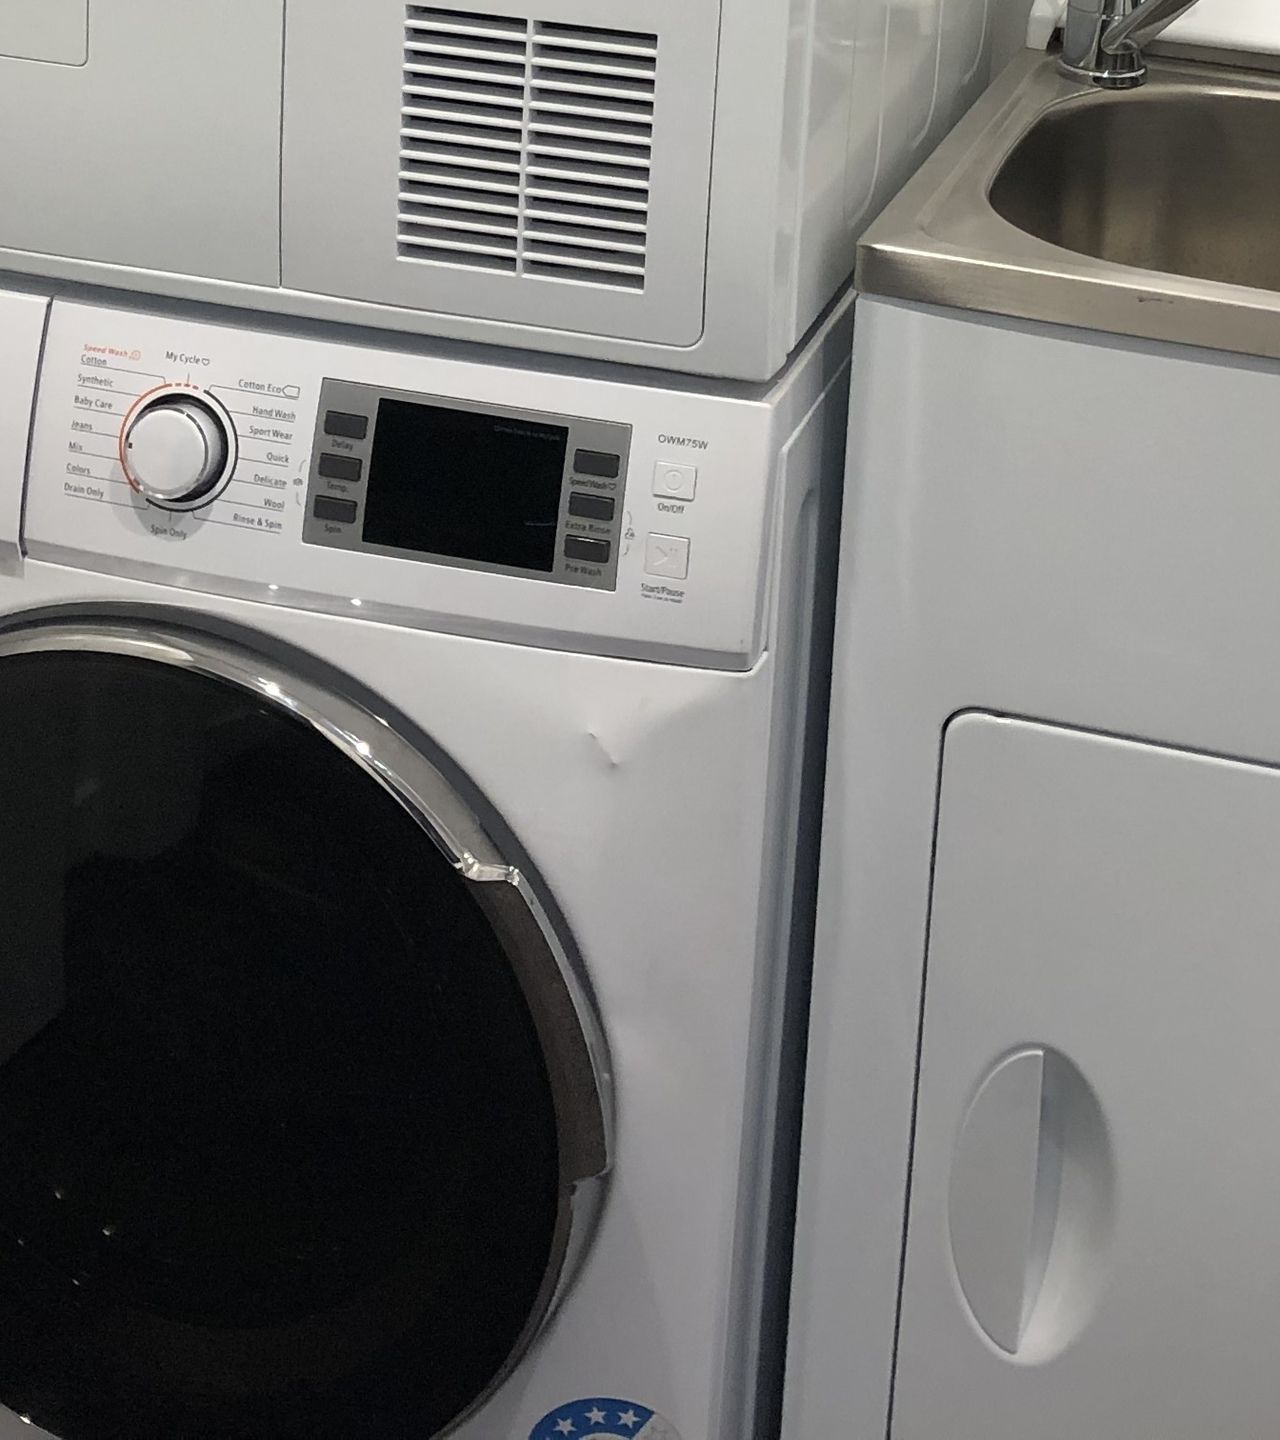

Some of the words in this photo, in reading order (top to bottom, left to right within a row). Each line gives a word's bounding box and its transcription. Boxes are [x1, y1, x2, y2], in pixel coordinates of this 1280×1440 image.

[80, 353, 107, 366] Cotton
[165, 351, 178, 362] My
[179, 354, 201, 365] Cycle
[77, 373, 113, 388] Synthetic
[238, 379, 265, 391] Cotton
[267, 383, 282, 394] Eco
[74, 395, 93, 408] Baby
[94, 398, 113, 410] Care
[252, 406, 273, 417] Hand
[274, 409, 296, 420] Wash
[72, 420, 93, 431] Jeans
[249, 425, 271, 437] Sport
[272, 429, 293, 440] Wear
[68, 440, 83, 451] Mix
[331, 439, 353, 452] Delay
[658, 433, 708, 451] OWM75W
[266, 451, 289, 464] Quick
[66, 462, 91, 475] Colors
[253, 474, 287, 488] Delicate
[64, 482, 86, 495] Drain
[87, 485, 104, 498] Only
[263, 498, 285, 509] Wool
[233, 512, 256, 526] Rinse
[256, 517, 263, 526] &
[264, 517, 282, 530] Spin
[565, 520, 586, 532] Extra
[150, 524, 167, 537] Spin
[170, 527, 187, 541] Only
[325, 523, 342, 535] Spin
[580, 566, 602, 577] Wash
